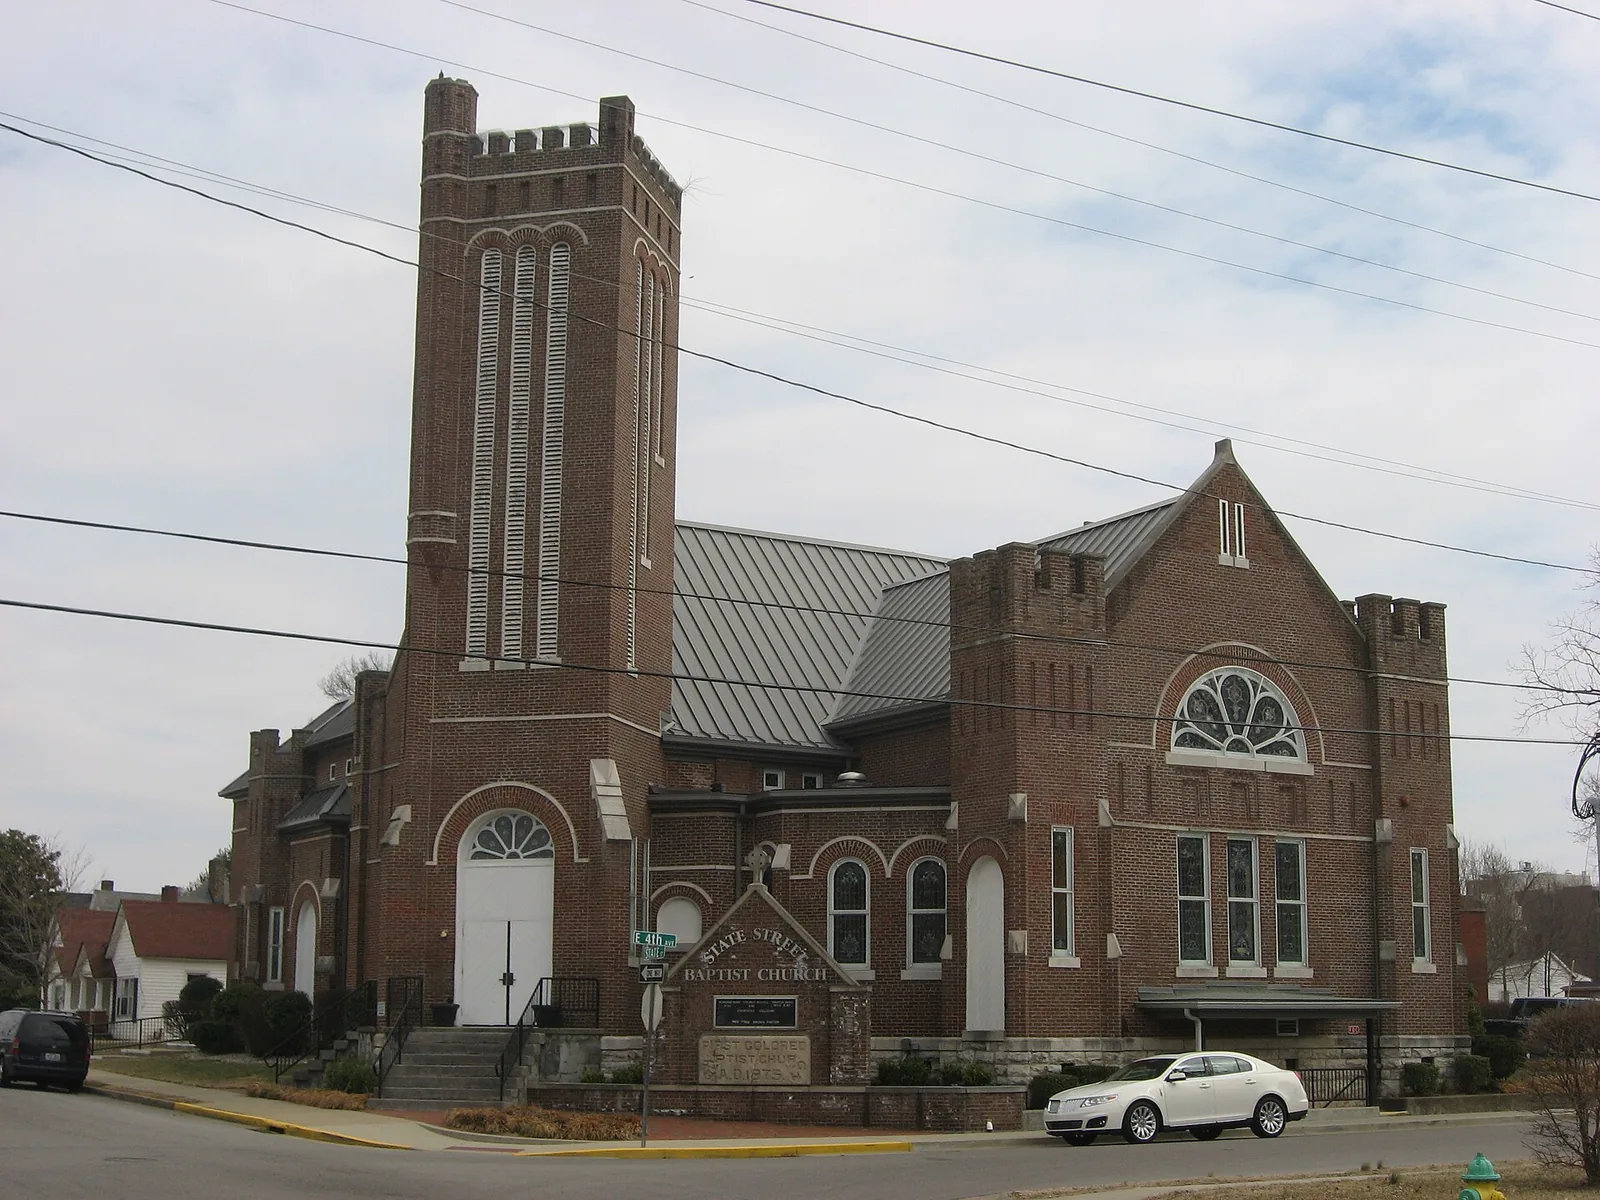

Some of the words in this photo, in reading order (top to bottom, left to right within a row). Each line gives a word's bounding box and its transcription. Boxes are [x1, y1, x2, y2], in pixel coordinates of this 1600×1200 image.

[635, 932, 641, 943] E
[645, 933, 662, 946] 4th
[703, 930, 746, 965] STATE
[753, 927, 809, 962] STREET
[684, 968, 751, 981] BAPTIST
[757, 968, 827, 981] CHURCH
[702, 1040, 740, 1051] FIRST
